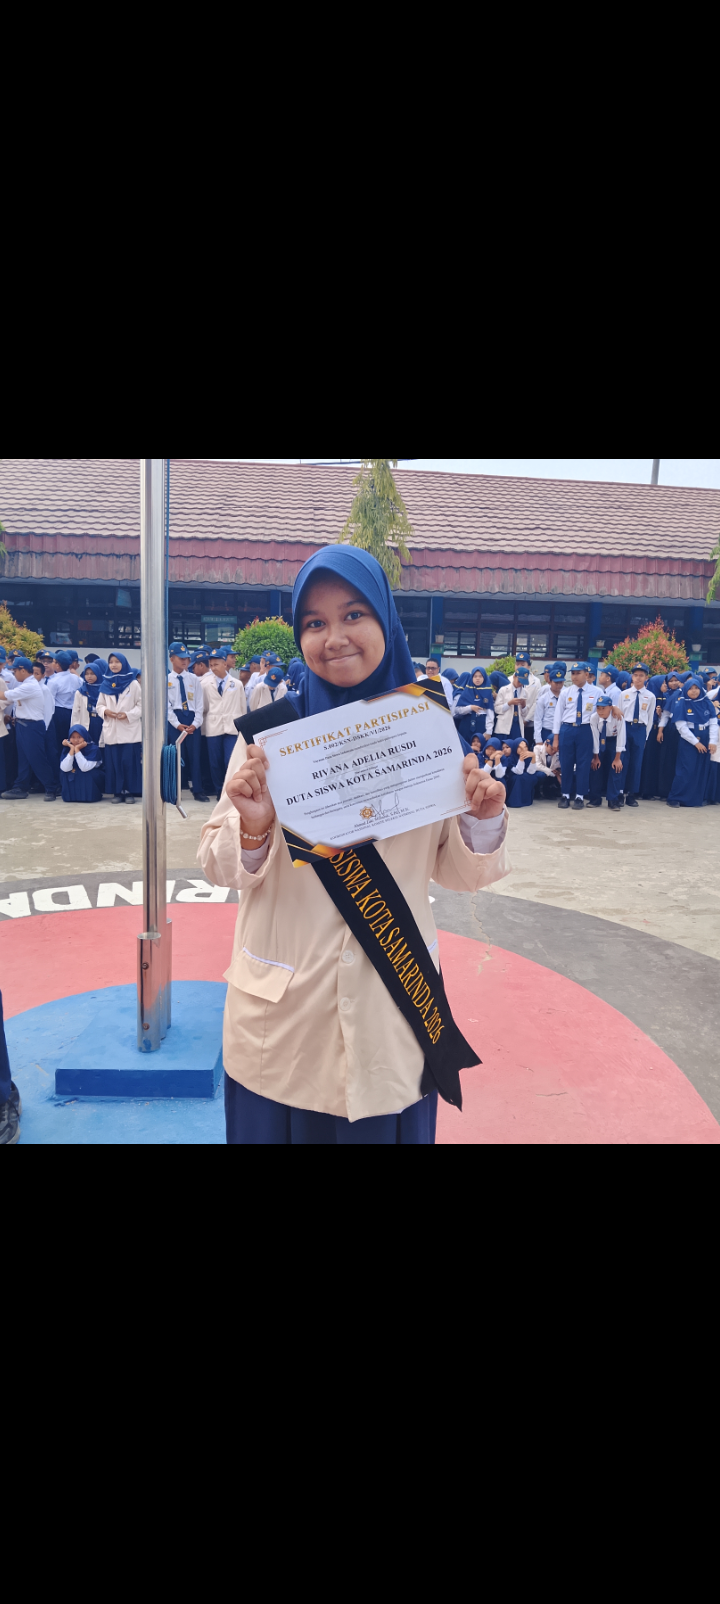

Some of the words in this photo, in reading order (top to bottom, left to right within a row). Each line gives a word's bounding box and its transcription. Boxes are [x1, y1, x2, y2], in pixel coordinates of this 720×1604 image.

[279, 727, 350, 756] SERTIFIKAT
[355, 702, 429, 732] PARTISIPASI
[286, 791, 313, 805] DUTA
[314, 782, 344, 796] SISWA
[345, 772, 373, 786] KOTA
[374, 753, 431, 776] SAMARINDA
[433, 745, 452, 758] 2026
[311, 762, 348, 779] RIVANA
[352, 751, 386, 766] ADELIA
[387, 740, 416, 755] RUSDI
[0, 880, 240, 919] RINDA
[355, 888, 395, 939] KOTA
[379, 927, 434, 1020] SAMARINDA
[423, 1006, 445, 1045] 2026
